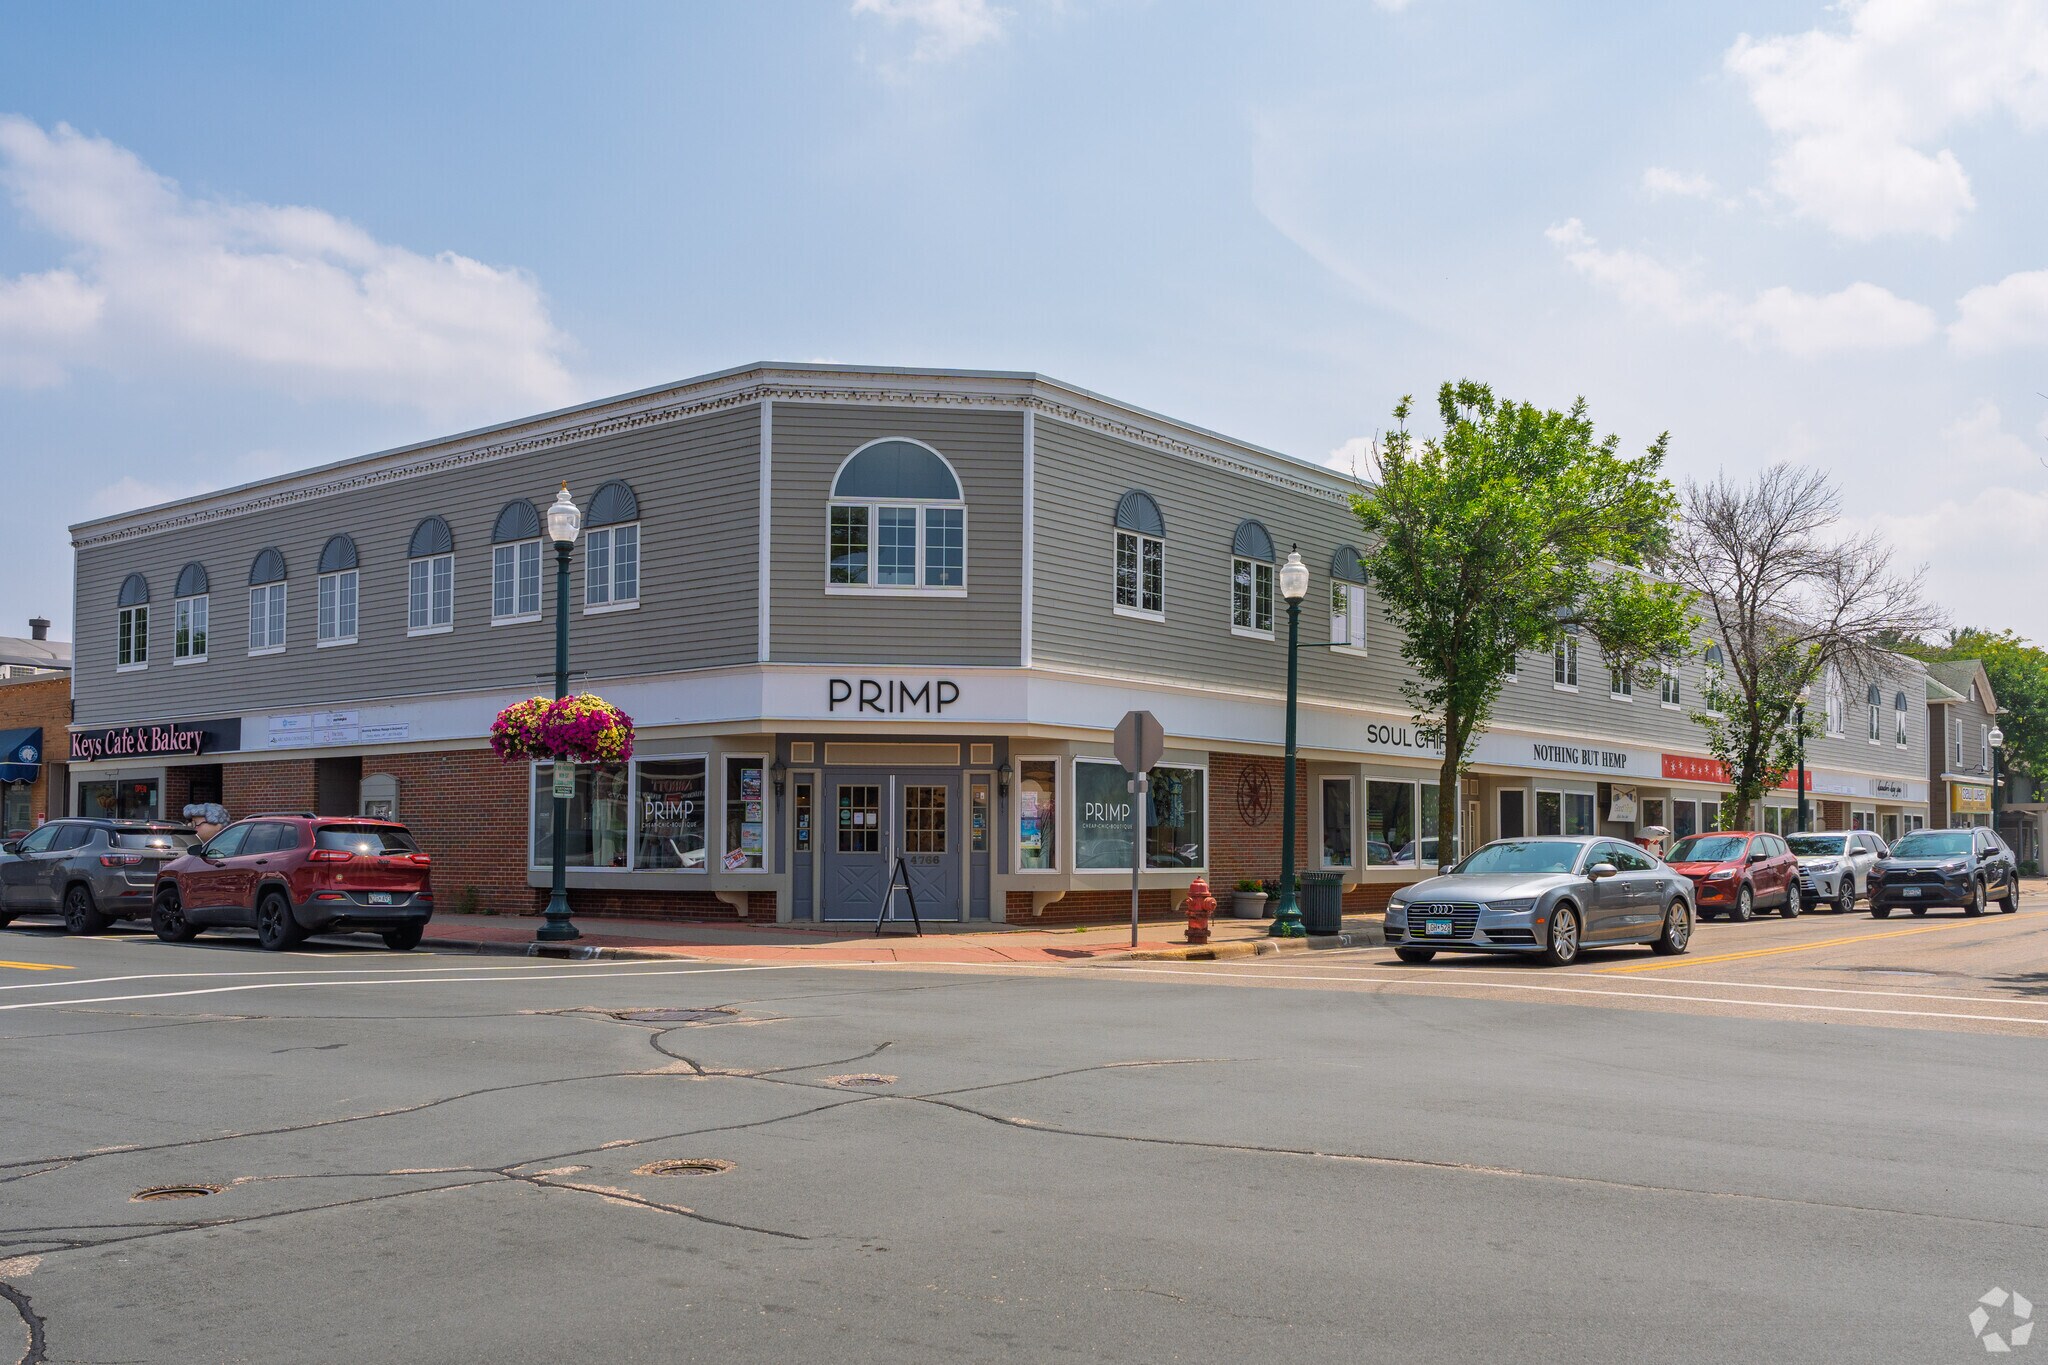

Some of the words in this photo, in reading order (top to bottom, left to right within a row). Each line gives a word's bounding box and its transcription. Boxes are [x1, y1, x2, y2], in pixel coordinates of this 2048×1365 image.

[829, 679, 960, 713] PRIMP
[72, 733, 101, 762] Keys
[105, 727, 134, 755] Cafe
[137, 727, 149, 754] &
[151, 723, 203, 756] Bakery
[1367, 724, 1412, 747] SOUL
[1533, 744, 1579, 764] NOTHING
[1581, 749, 1599, 766] BUT
[1601, 751, 1627, 769] HEMP
[645, 800, 694, 820] PRIMP
[1085, 802, 1131, 821] PRIMP
[911, 855, 940, 865] 4766
